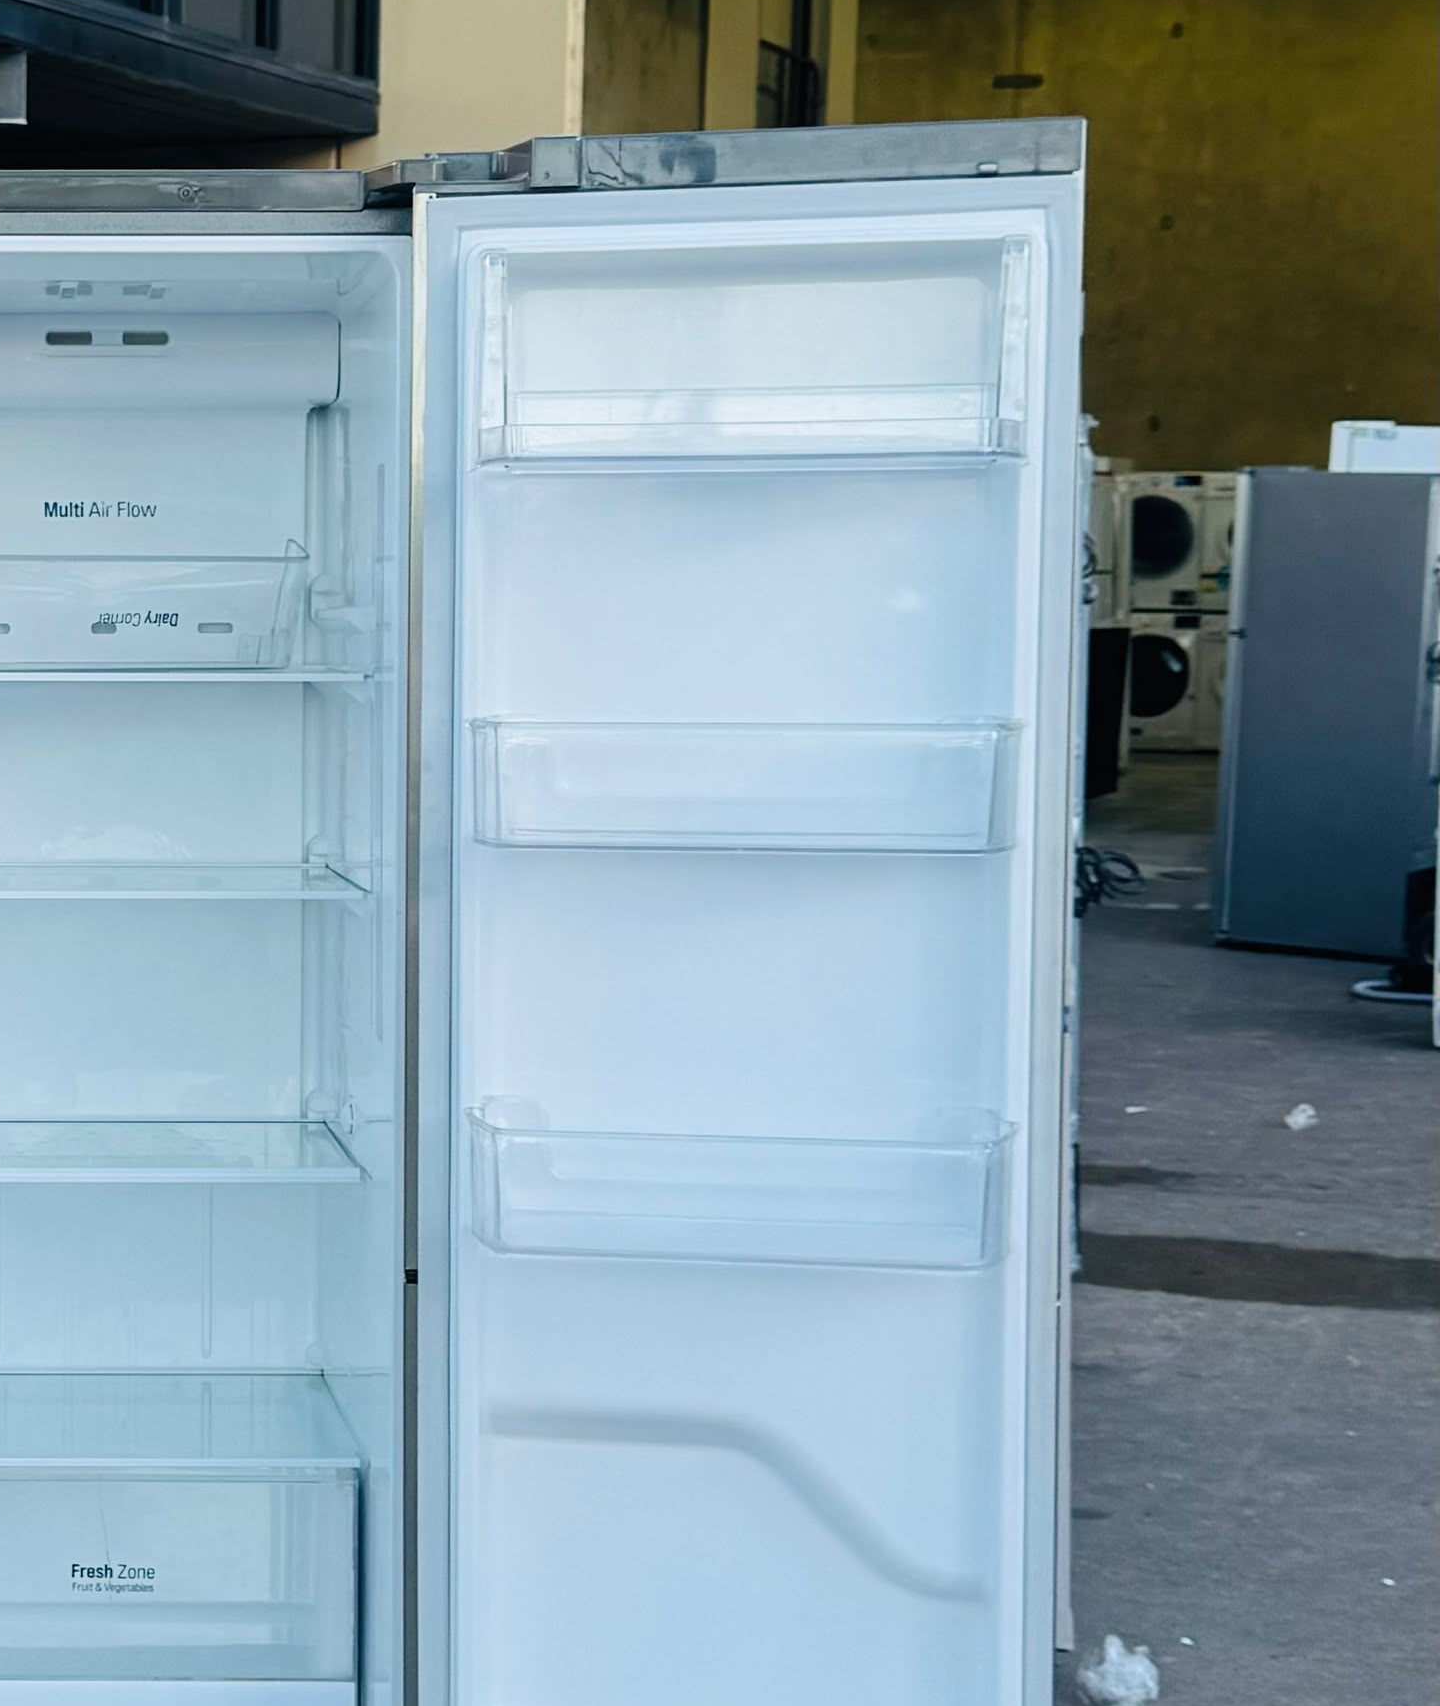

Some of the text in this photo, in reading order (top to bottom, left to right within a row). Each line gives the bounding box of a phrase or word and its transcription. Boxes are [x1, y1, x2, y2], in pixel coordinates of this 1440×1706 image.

[43, 501, 157, 518] Multi Air Flow
[99, 610, 180, 627] Dairy Corner
[71, 1563, 156, 1580] Fresh Zone
[72, 1581, 154, 1594] Fruit & Vegetables
